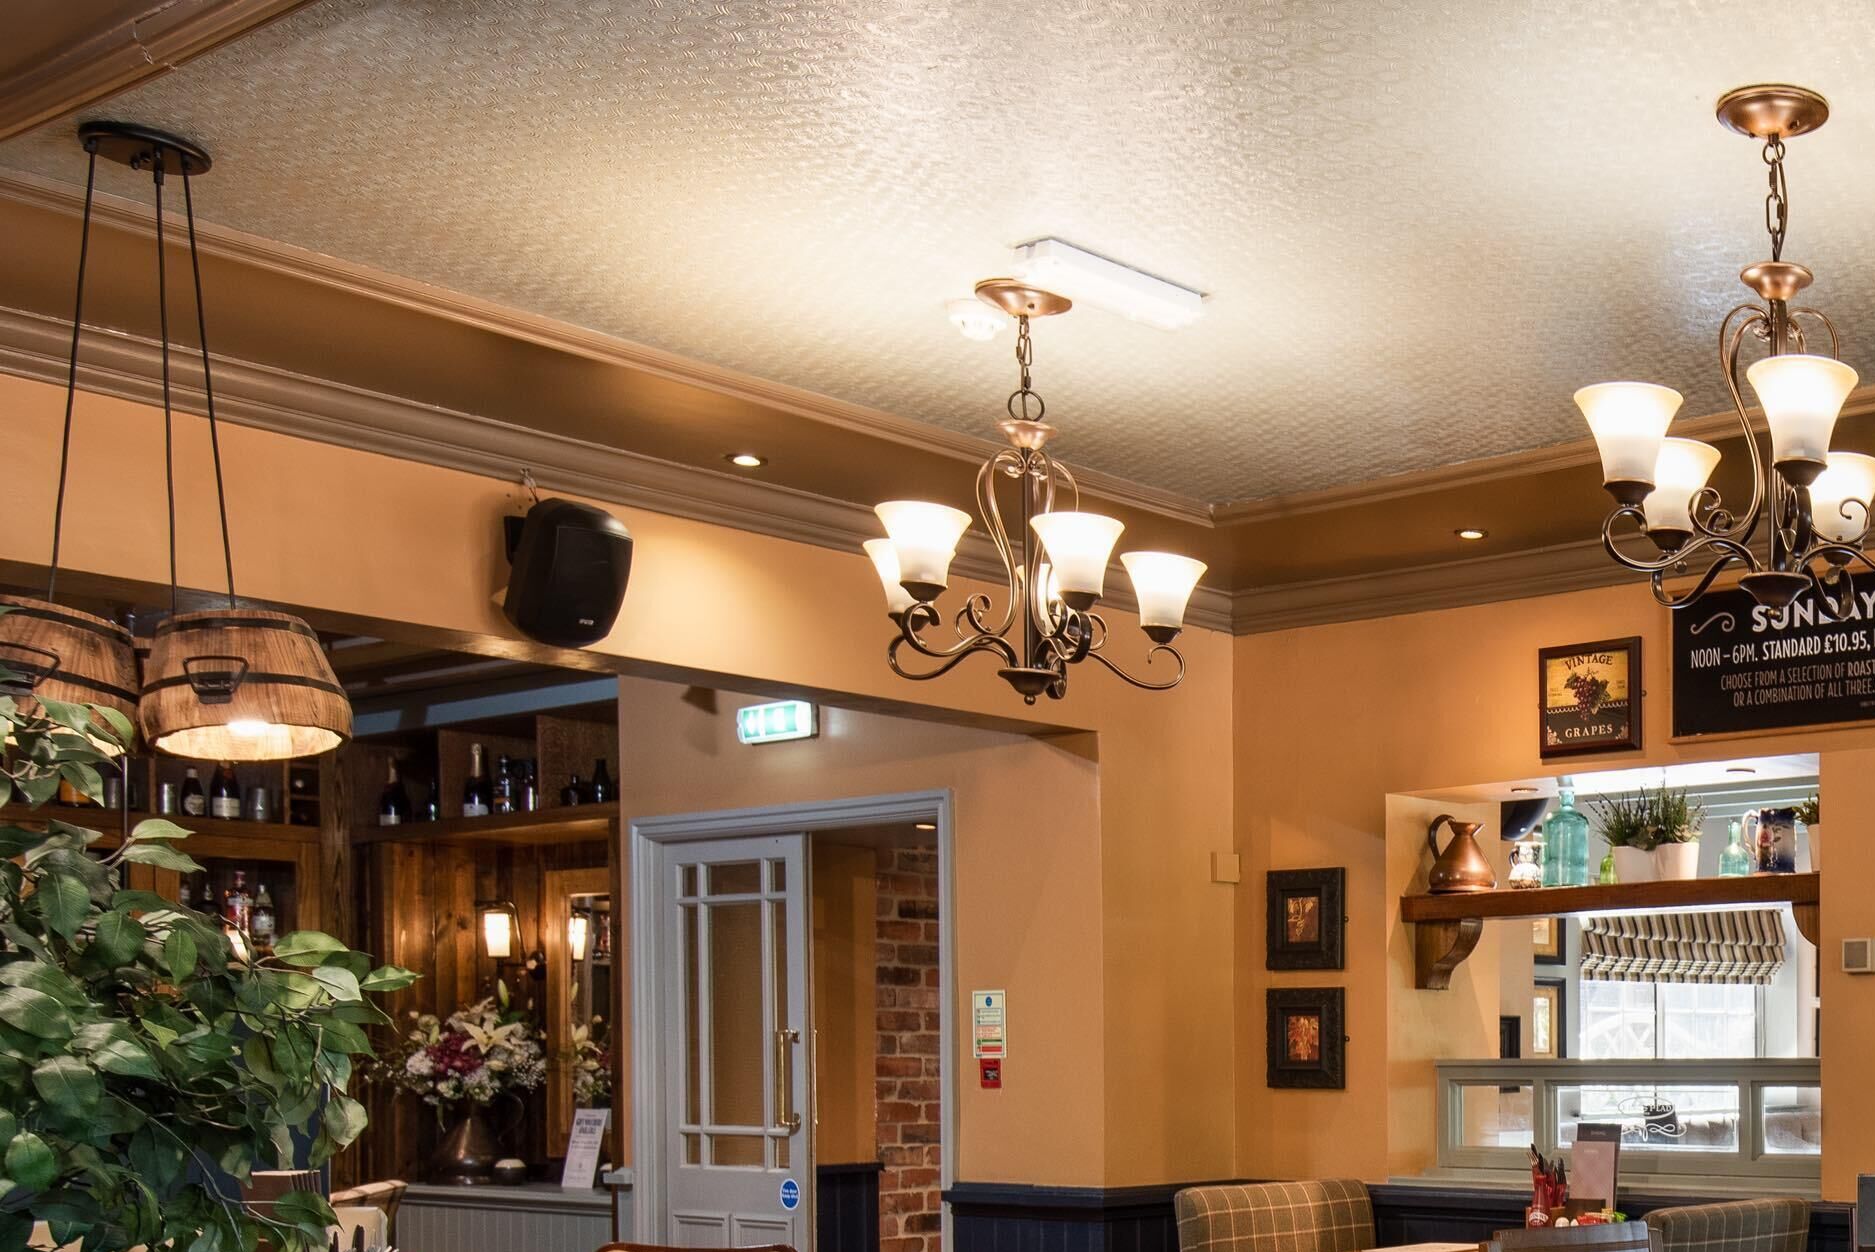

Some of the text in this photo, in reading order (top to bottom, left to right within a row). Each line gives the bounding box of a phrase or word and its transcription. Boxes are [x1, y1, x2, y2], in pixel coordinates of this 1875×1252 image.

[1564, 654, 1614, 671] VINTAGE
[1691, 647, 1721, 669] NOON
[1732, 642, 1758, 664] 6PM.
[1762, 638, 1821, 661] STANDARD
[1824, 629, 1871, 654] £10.95,
[1721, 673, 1752, 690] CHOOSE
[1755, 671, 1777, 686] FROM
[1779, 671, 1786, 684] A
[1787, 666, 1833, 683] SELECTION
[1834, 662, 1846, 678] OF
[1847, 659, 1875, 677] ROAST
[1733, 691, 1744, 707] OR
[1747, 690, 1753, 705] A
[1754, 683, 1813, 705] COMBINATION
[1814, 683, 1825, 697] OF
[1827, 681, 1843, 697] ALL
[1845, 678, 1875, 696] THREE.
[1565, 723, 1613, 738] GRAPES
